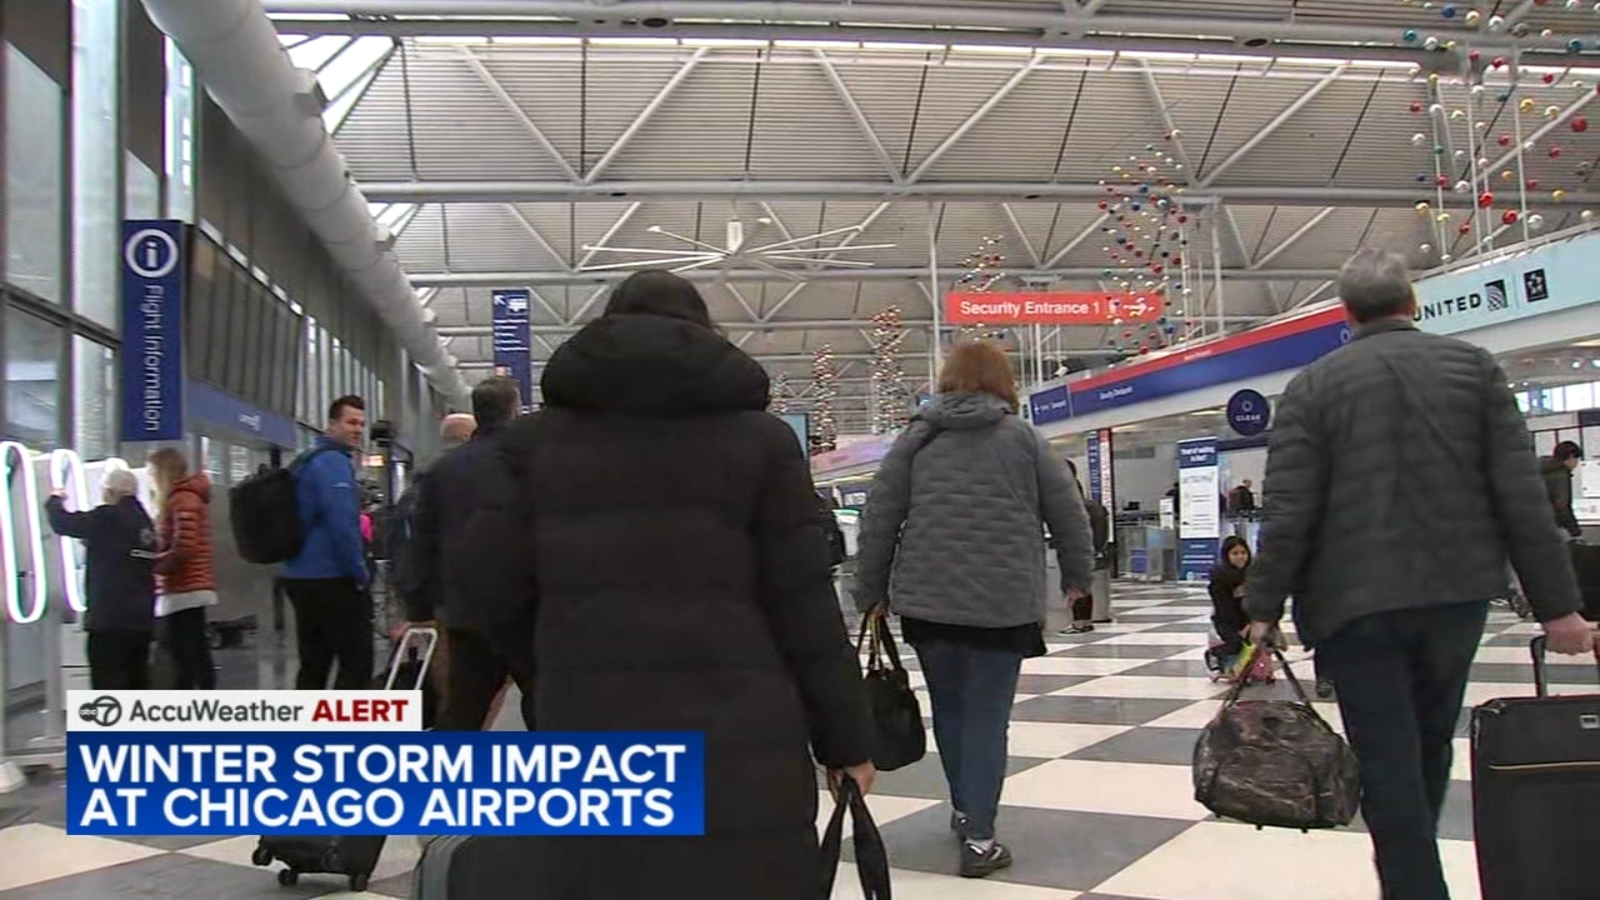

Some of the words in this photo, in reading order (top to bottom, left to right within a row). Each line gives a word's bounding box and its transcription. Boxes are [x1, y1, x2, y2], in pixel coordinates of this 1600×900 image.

[141, 284, 165, 330] Flight
[959, 301, 1021, 317] Security
[1024, 302, 1089, 315] Entrance
[1092, 302, 1100, 315] 1
[1412, 292, 1482, 322] UNITED
[144, 335, 165, 432] Information
